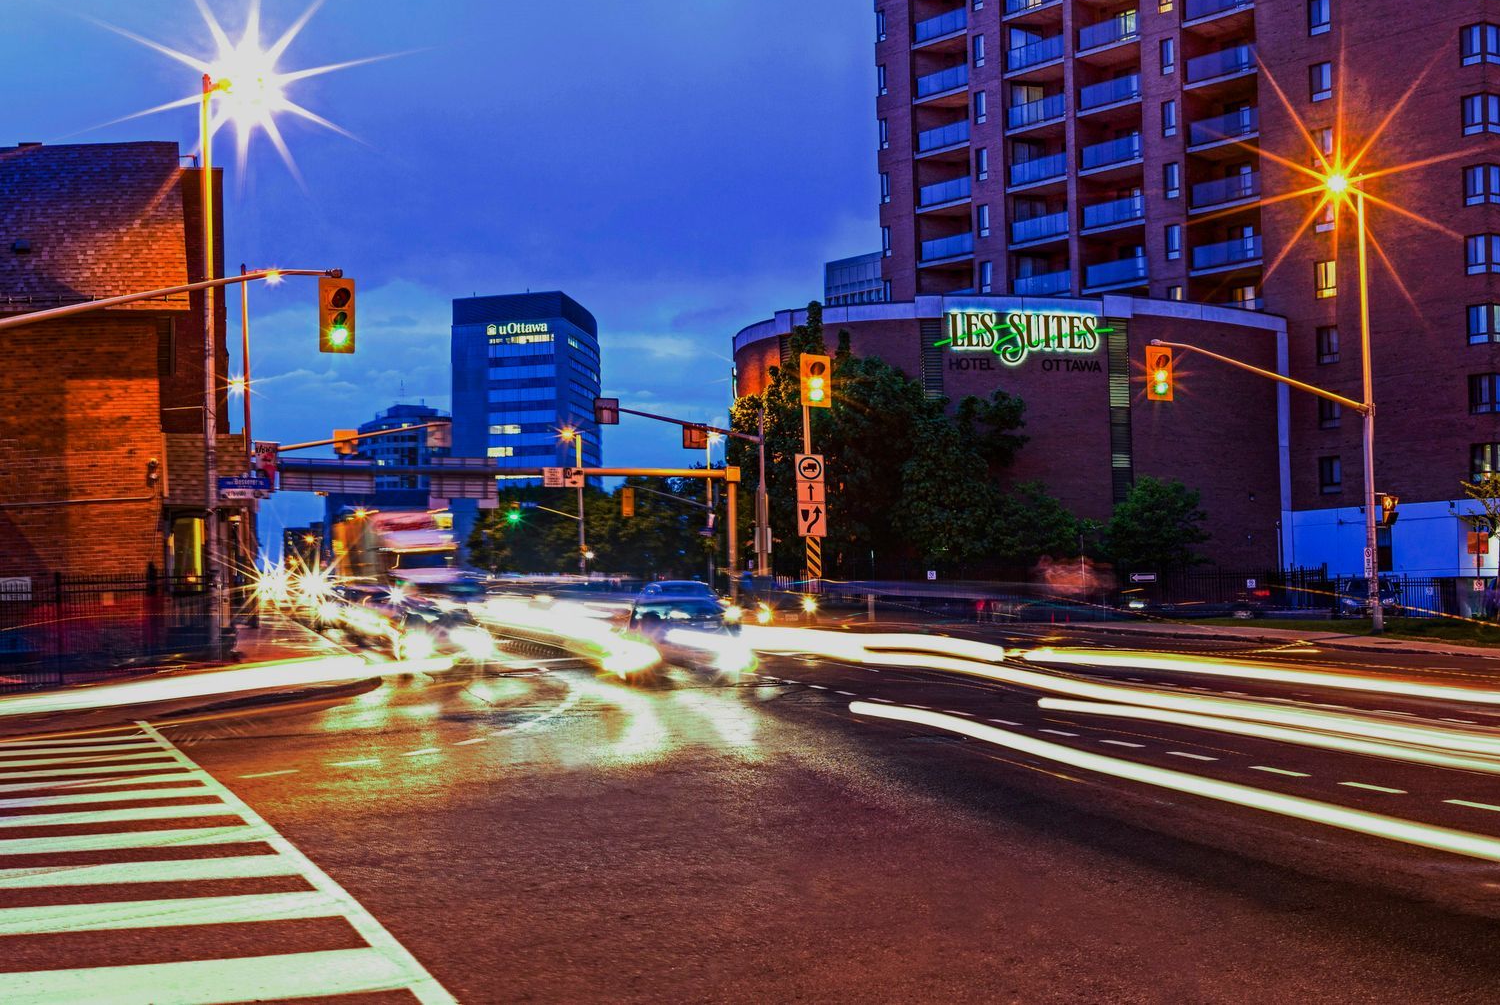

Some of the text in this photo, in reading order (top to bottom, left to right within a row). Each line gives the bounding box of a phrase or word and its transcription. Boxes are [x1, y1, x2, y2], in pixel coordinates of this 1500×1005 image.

[498, 322, 548, 335] uOttawa
[950, 313, 1097, 363] LES SUITES
[950, 358, 1102, 373] HOTEL OTTAWA
